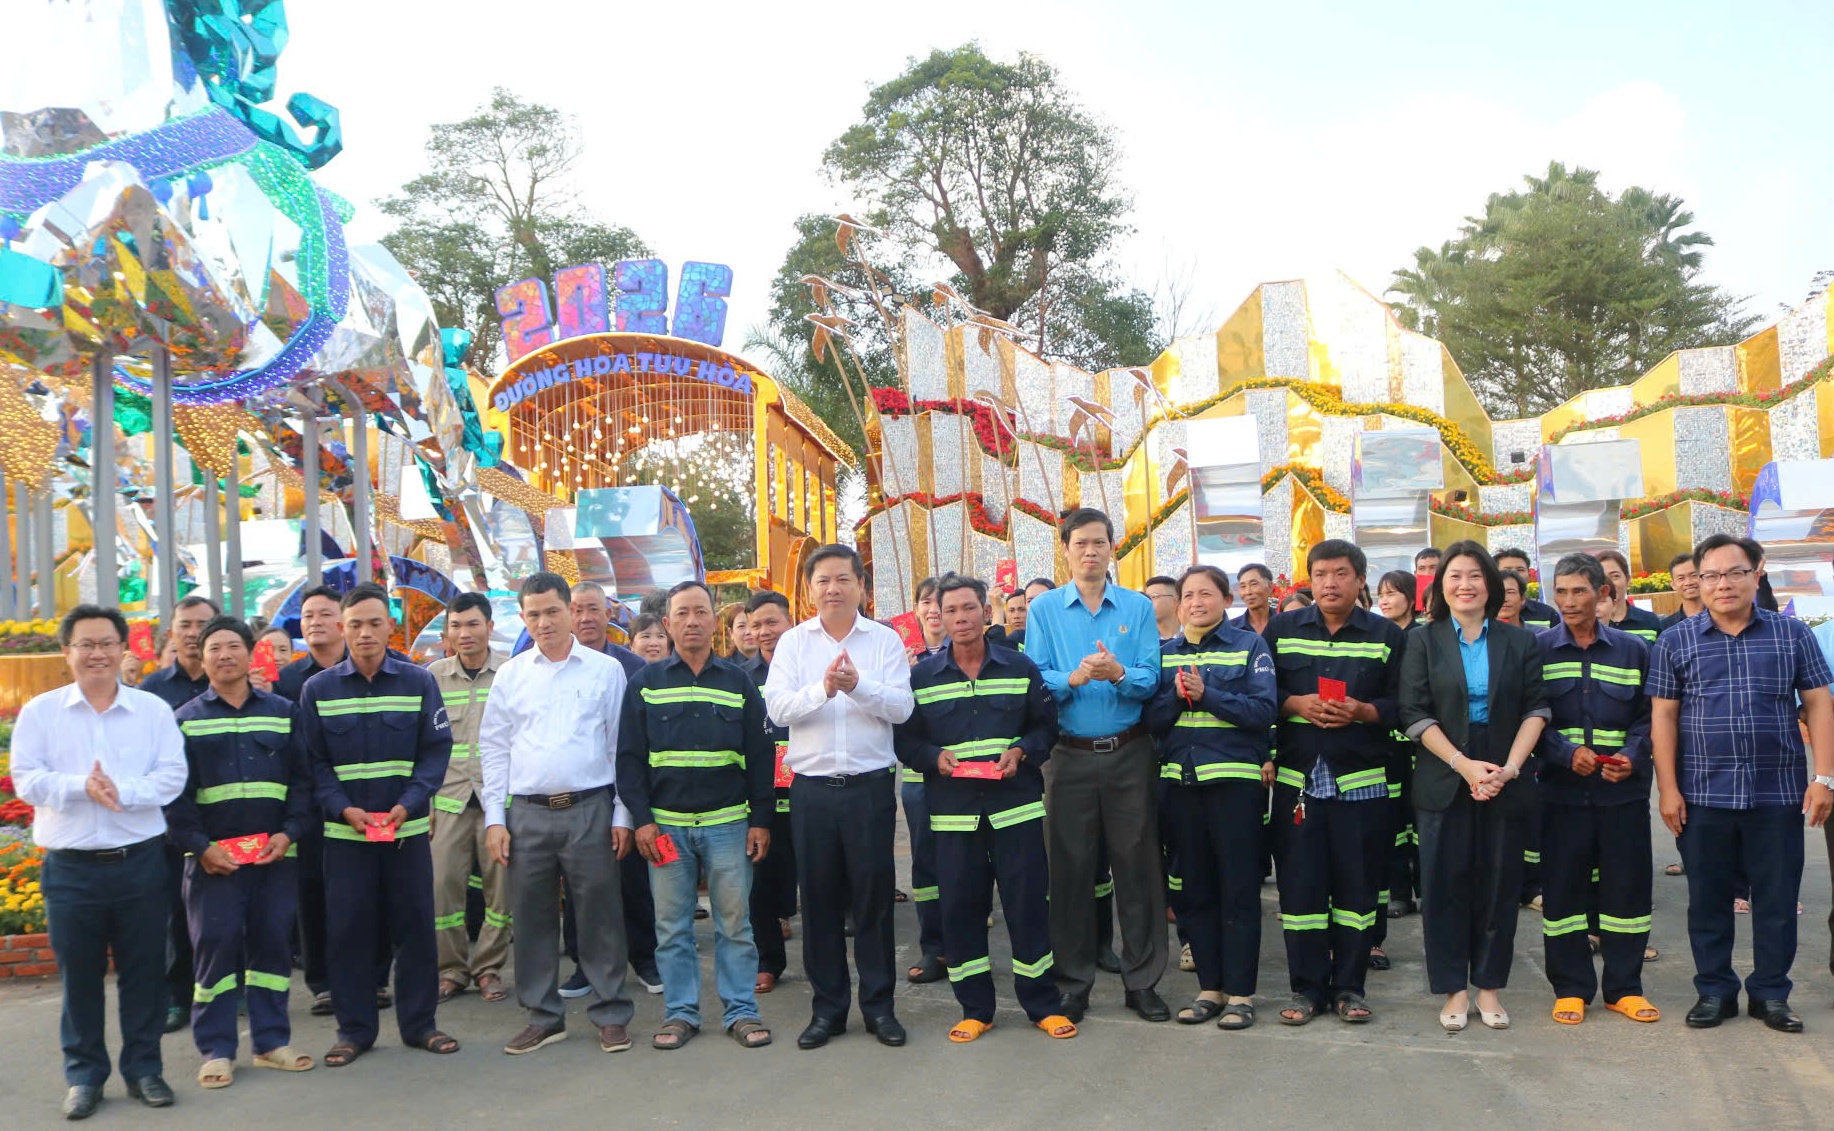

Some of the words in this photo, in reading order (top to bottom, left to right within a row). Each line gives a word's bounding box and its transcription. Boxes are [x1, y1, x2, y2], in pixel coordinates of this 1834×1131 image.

[494, 258, 733, 364] 2026
[494, 363, 571, 412] ĐƯỜNG
[575, 353, 631, 378] HOA
[697, 361, 752, 395] HÒA
